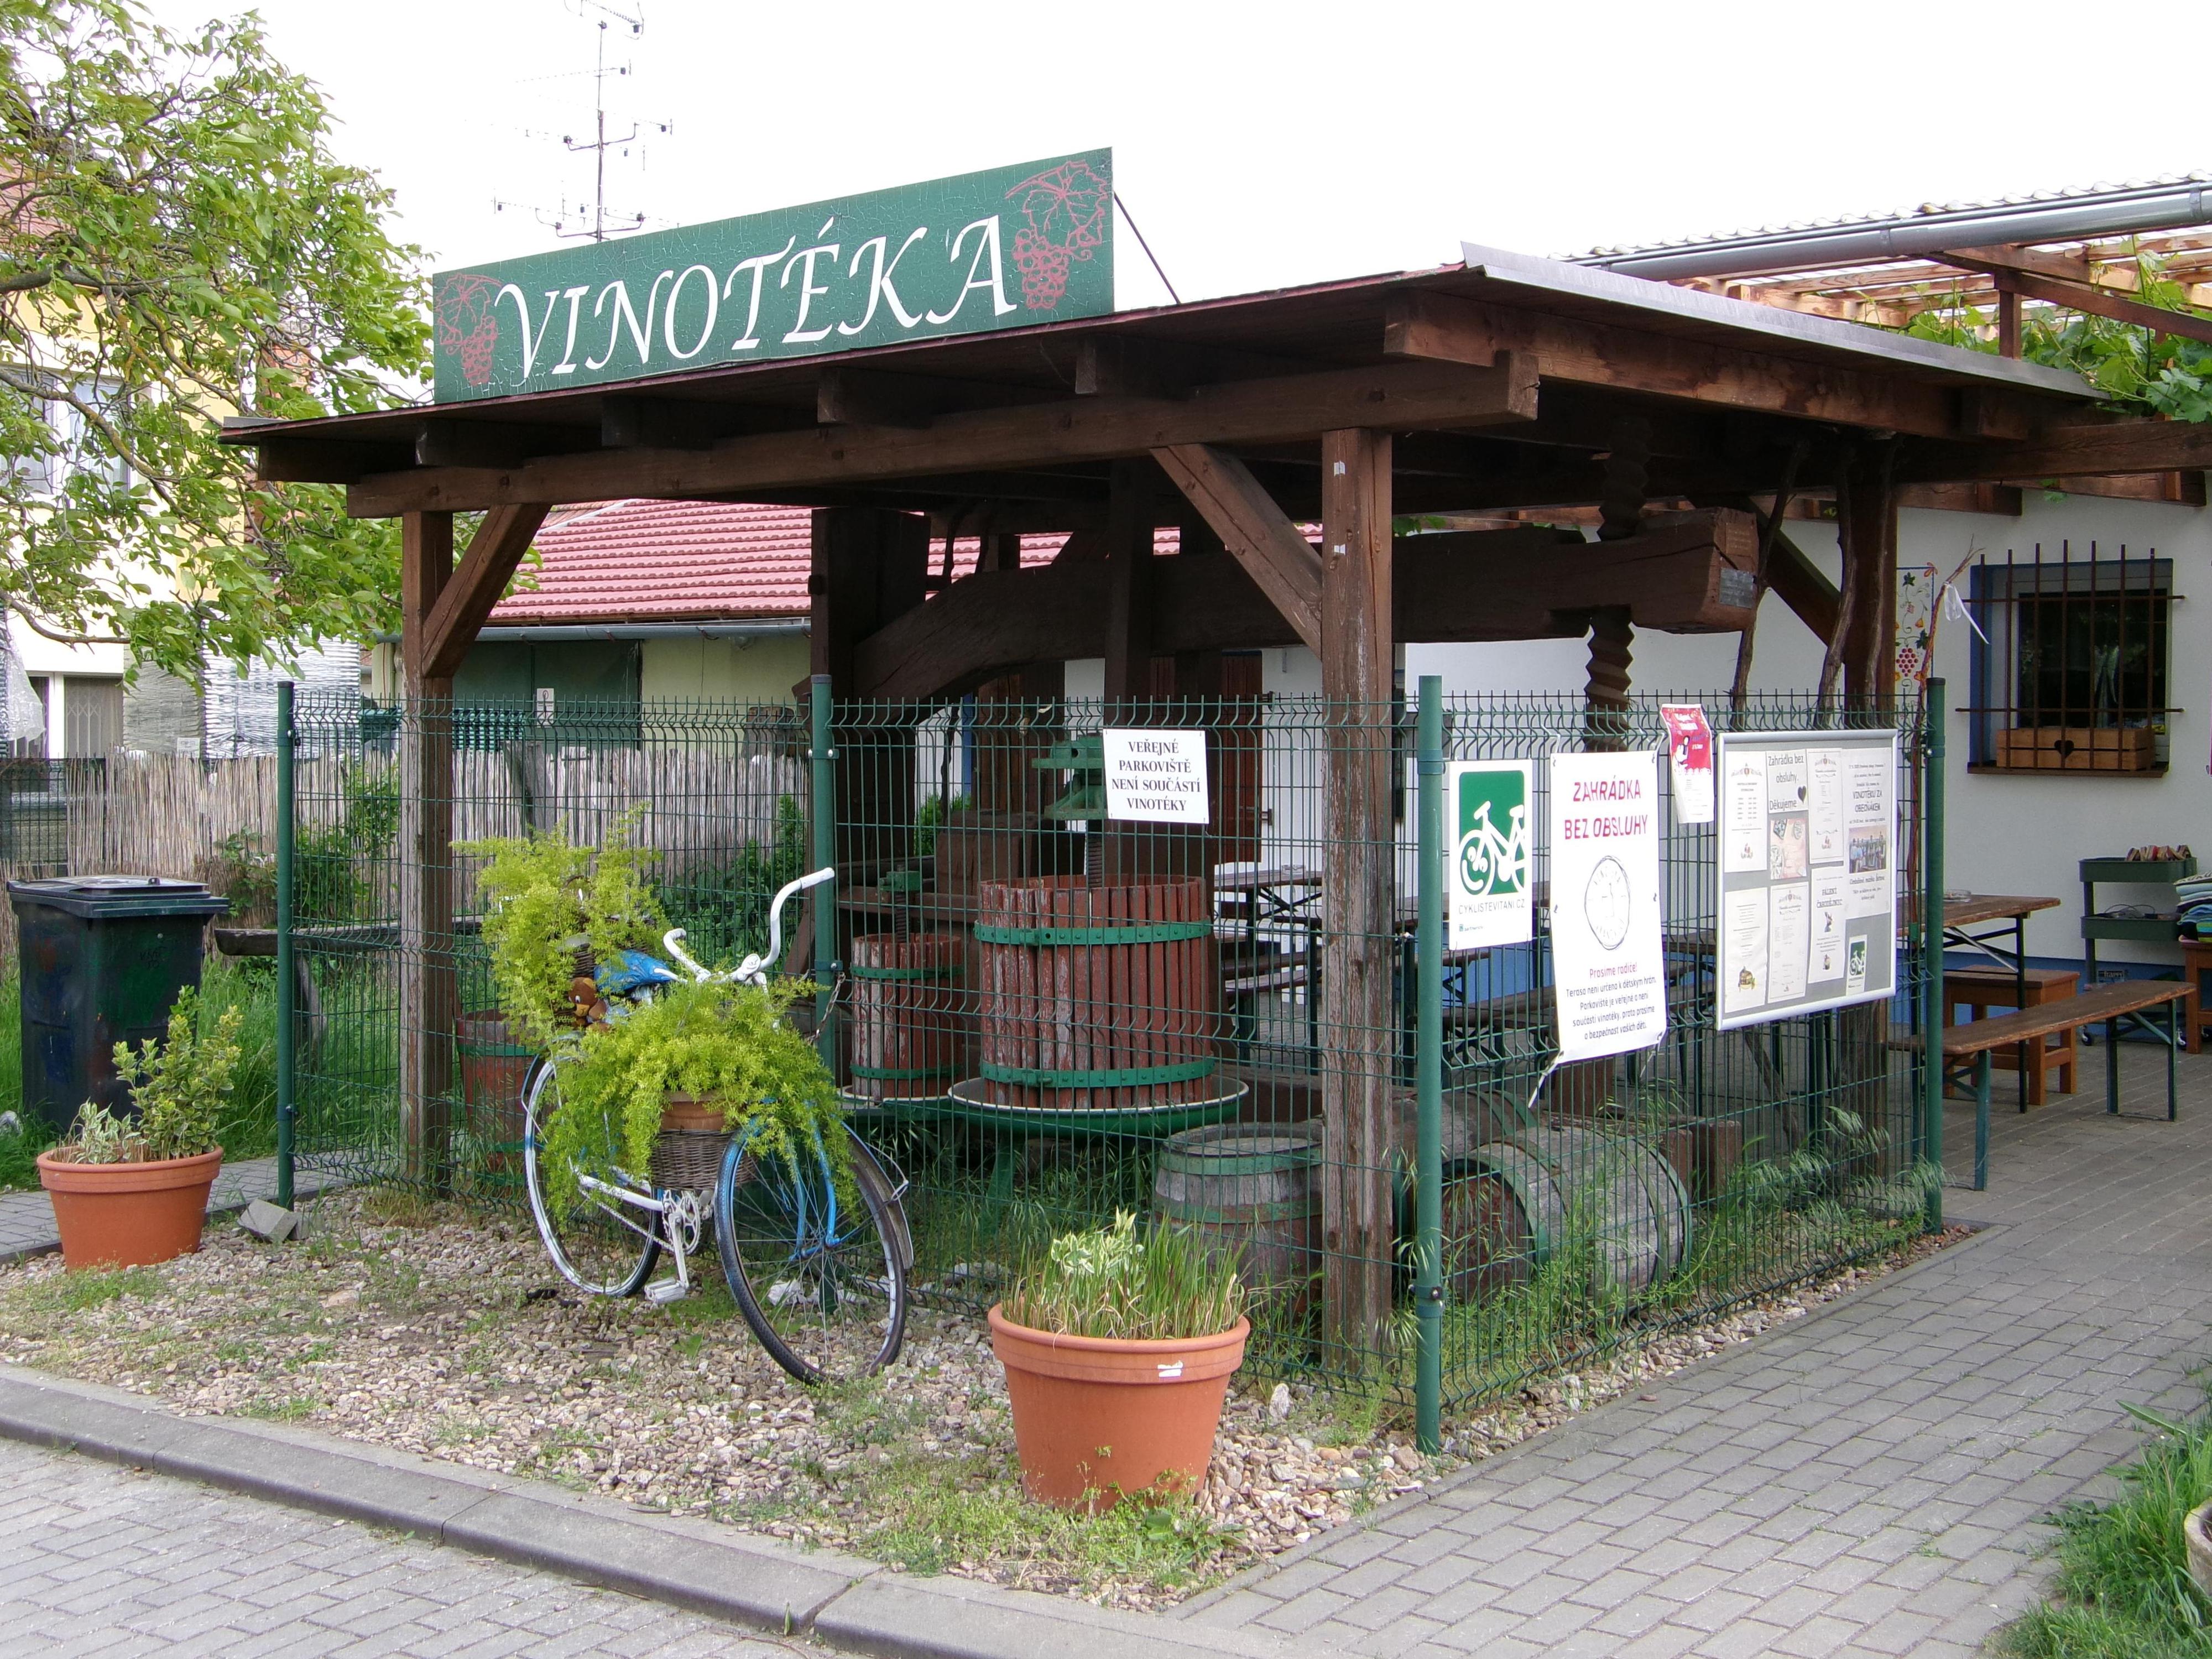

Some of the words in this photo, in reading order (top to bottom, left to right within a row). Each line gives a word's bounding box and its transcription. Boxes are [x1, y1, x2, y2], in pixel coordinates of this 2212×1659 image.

[495, 216, 1018, 385] VINOTÉKA
[1128, 739, 1179, 755] VEŘEJNÉ
[1119, 758, 1191, 773] PARKOVIŠTĚ
[1768, 754, 1793, 766] Zahrádka
[1794, 753, 1804, 764] bez
[1112, 776, 1138, 790] NENÍ
[1142, 777, 1201, 792] SOUČÁSTÍ
[1573, 775, 1641, 801] ZAHRÁDKA
[1127, 796, 1186, 811] VINOTÉKY
[1770, 799, 1797, 811] Děkujeme
[1565, 818, 1589, 839] BEZ
[1593, 815, 1647, 837] OBSLUHY
[1566, 989, 1586, 997] Terasa
[1600, 982, 1618, 992] určena
[1580, 998, 1608, 1010] Parkoviště
[1622, 1009, 1635, 1019] proto
[1589, 1026, 1619, 1039] bezpečnost
